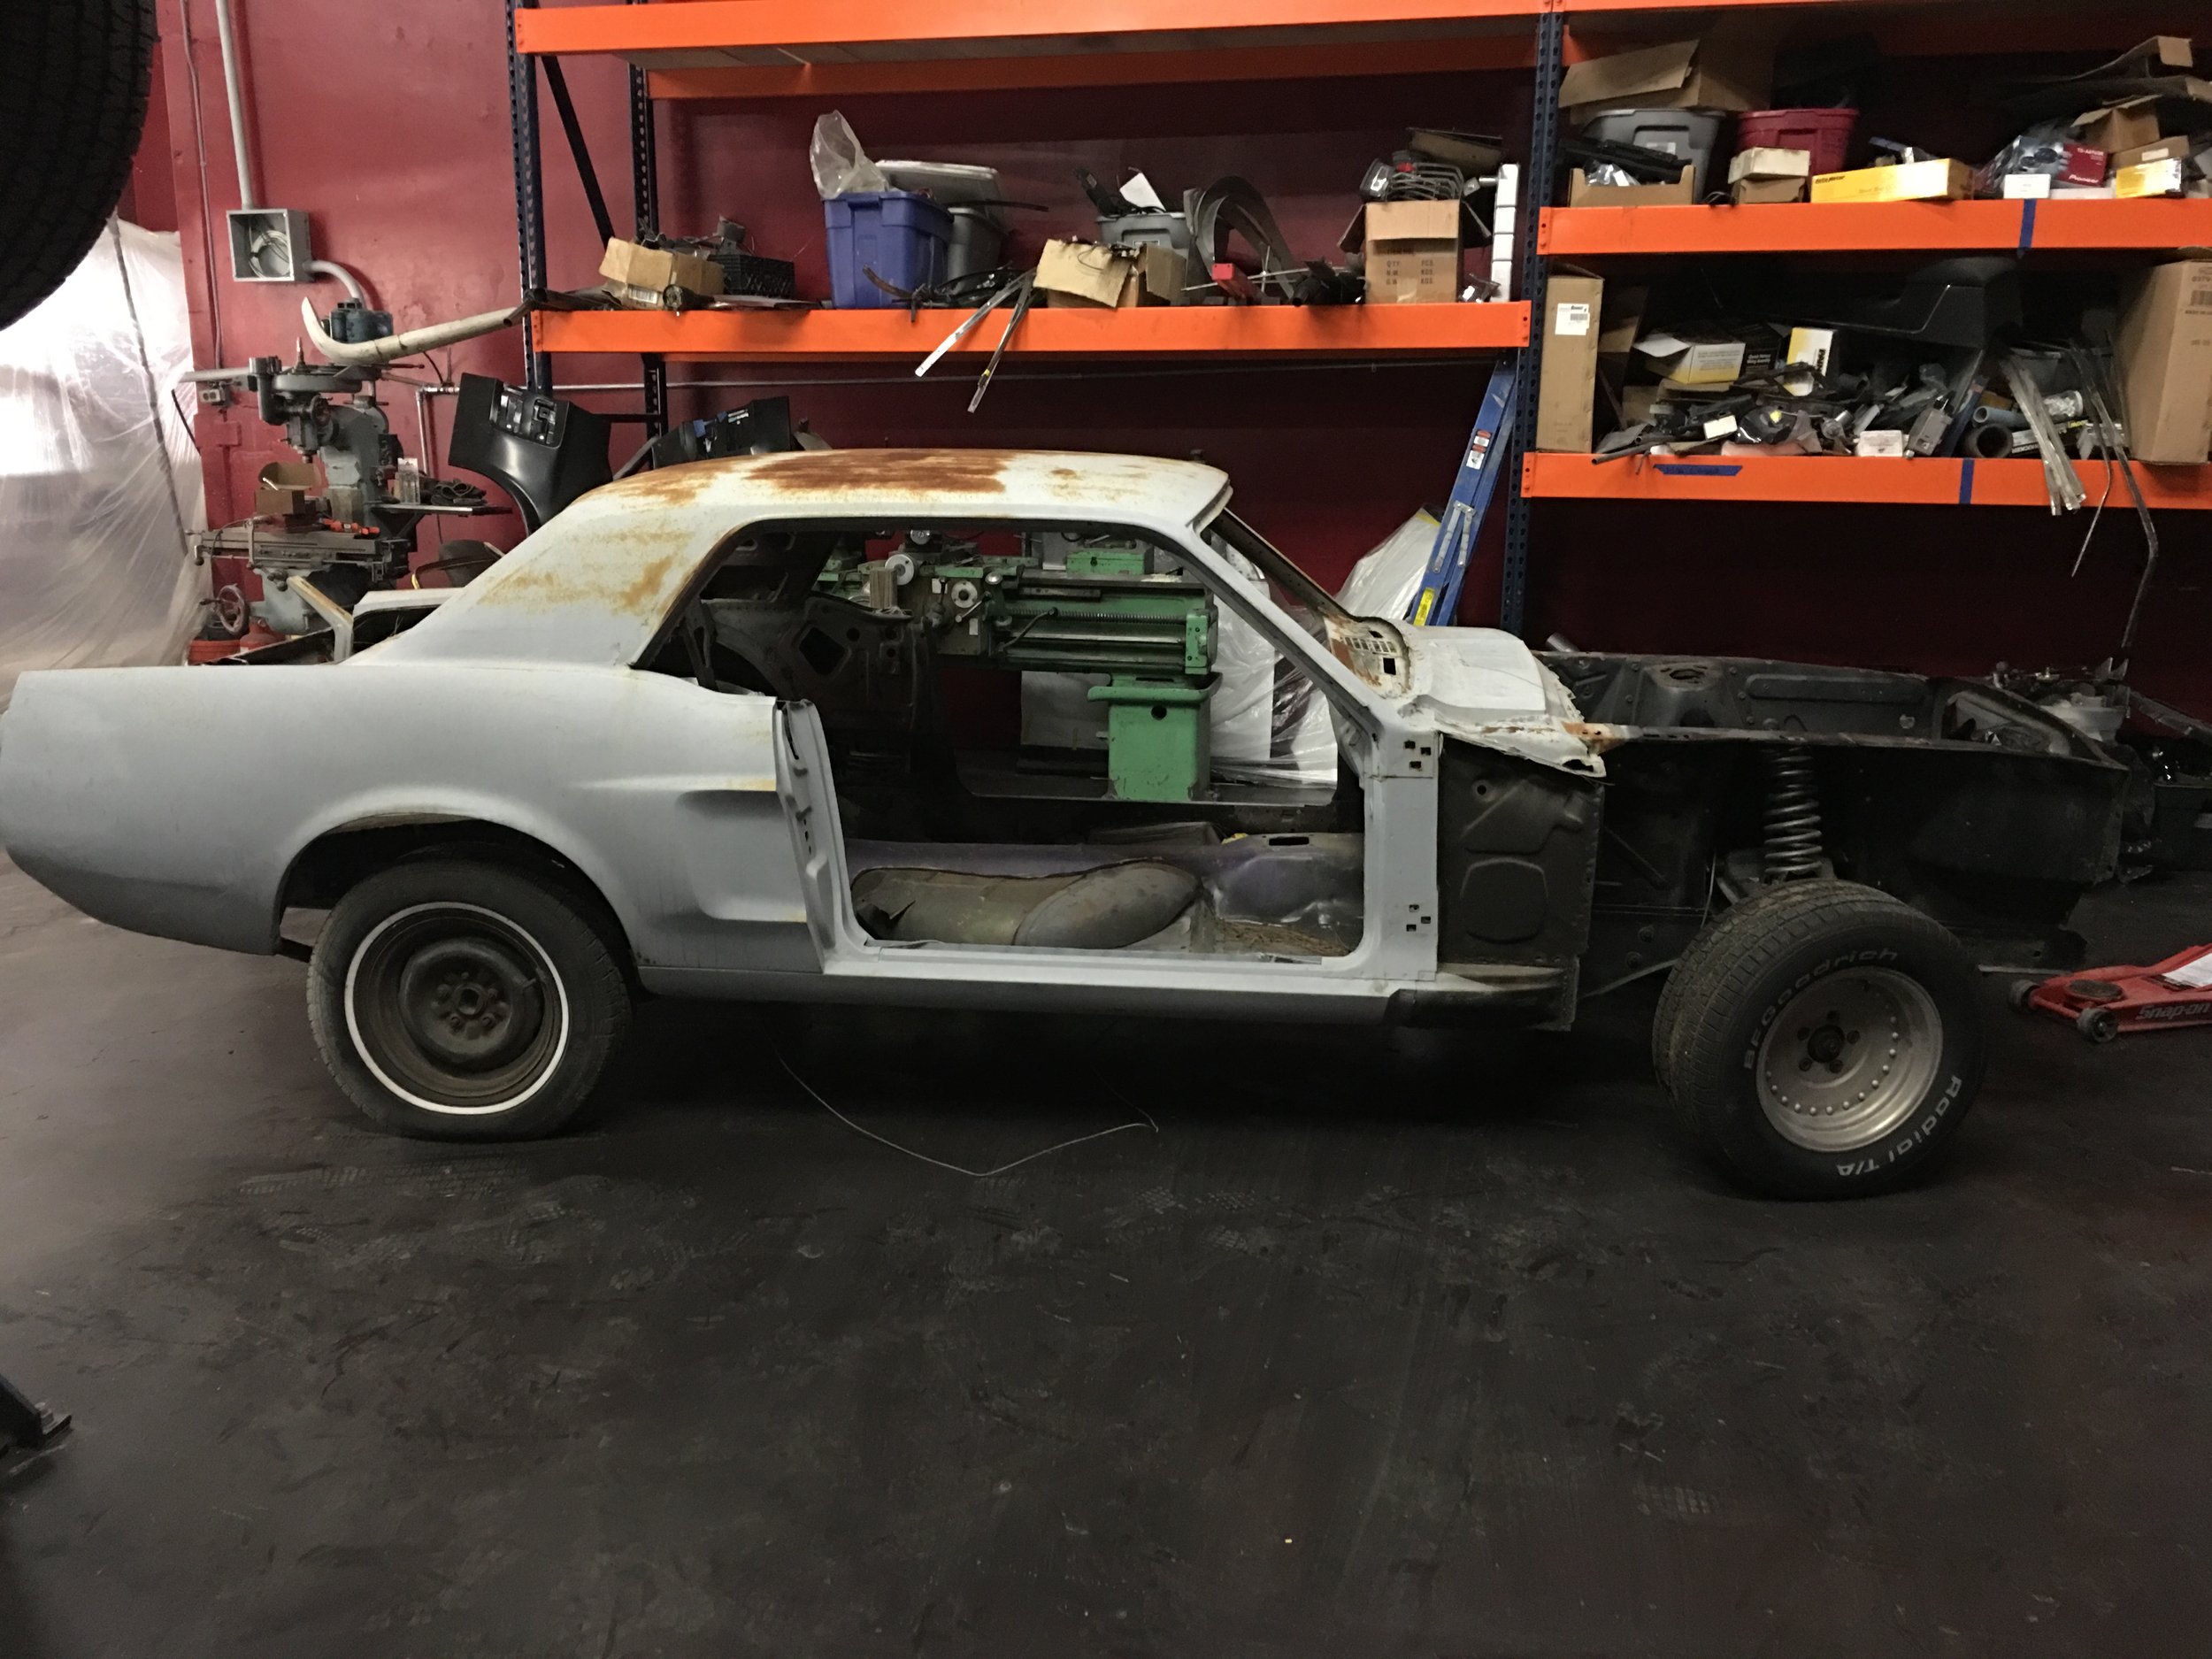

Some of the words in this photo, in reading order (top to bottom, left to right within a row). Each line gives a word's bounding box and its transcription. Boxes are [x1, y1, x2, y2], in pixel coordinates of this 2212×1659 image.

[2069, 173, 2099, 184] Pioneer
[1743, 949, 1899, 1070] BFGoodrich
[1887, 1074, 1963, 1164] Radial
[1836, 1157, 1880, 1177] T/A
